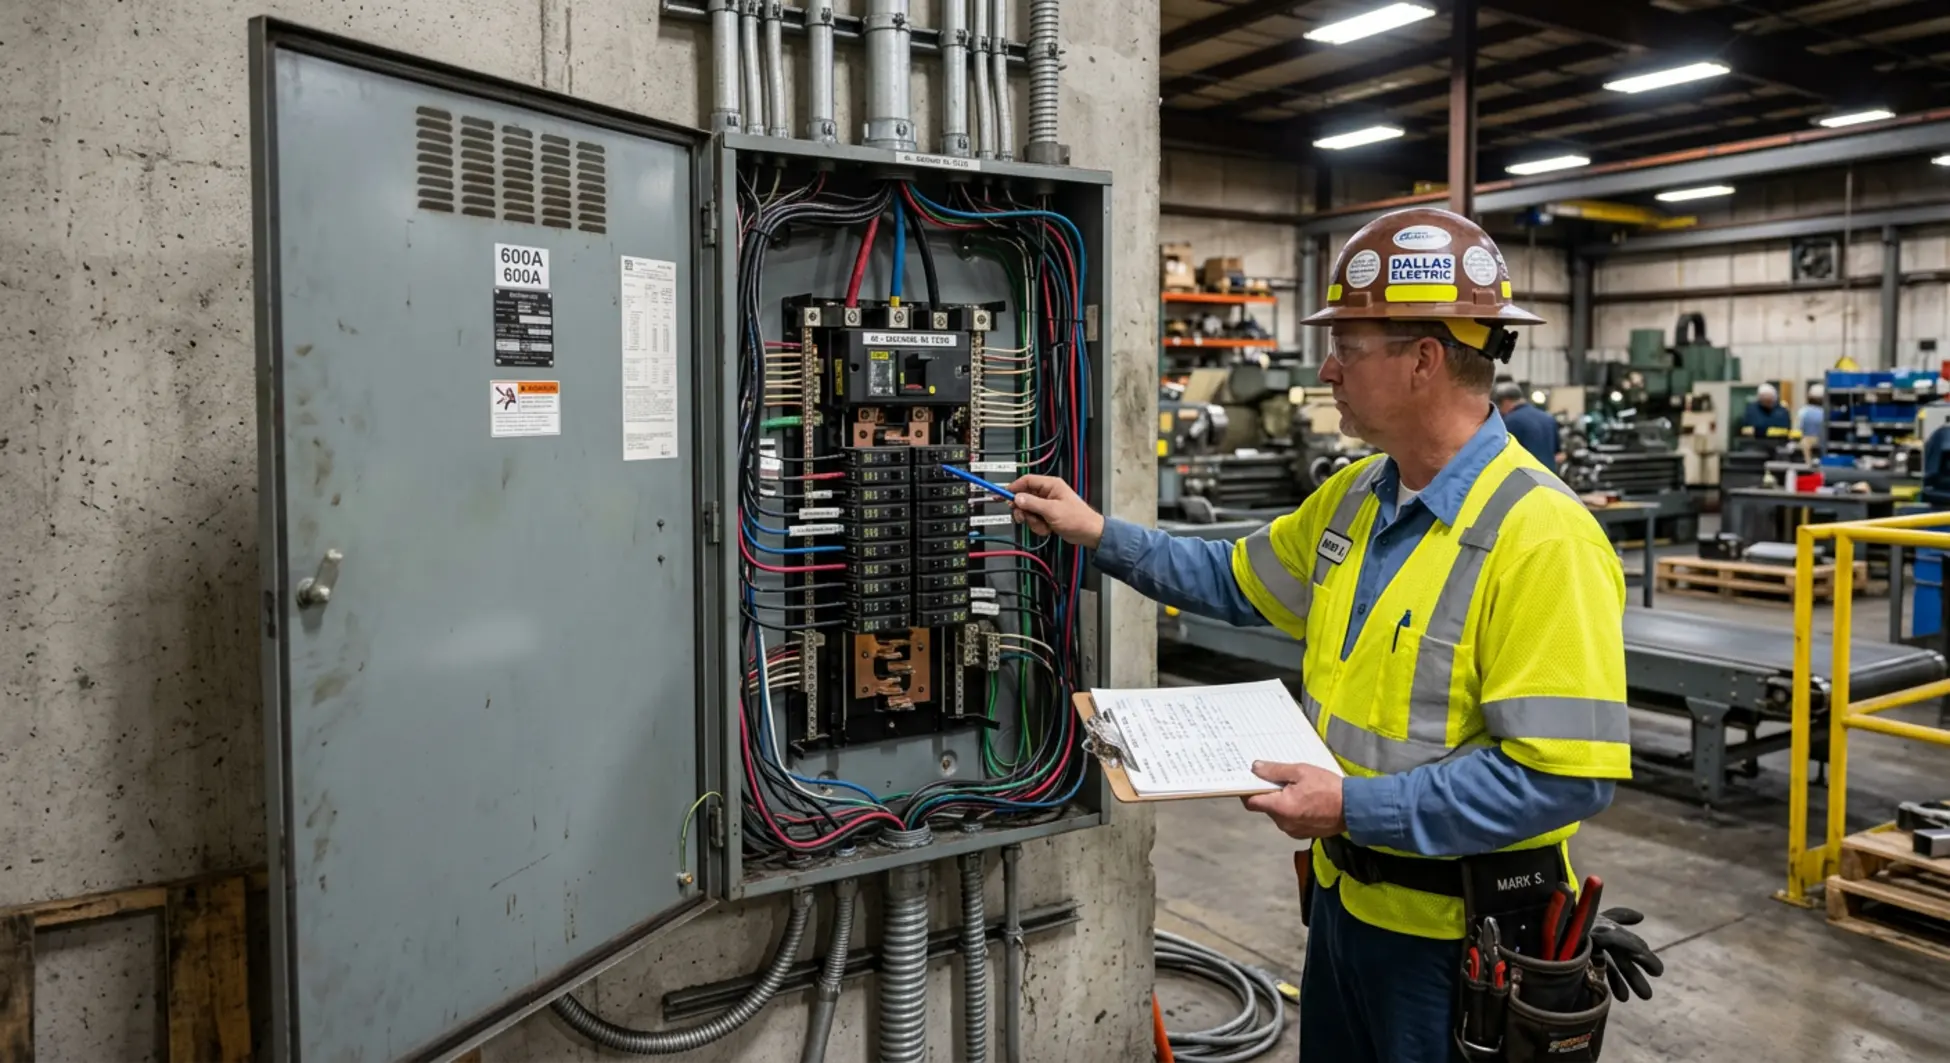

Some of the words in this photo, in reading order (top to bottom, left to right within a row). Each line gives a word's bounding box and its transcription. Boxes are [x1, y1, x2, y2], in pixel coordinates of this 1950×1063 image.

[501, 247, 544, 267] 600A
[1392, 258, 1452, 269] DALLAS
[504, 267, 541, 284] 600A
[1497, 875, 1531, 890] MARK
[1534, 871, 1545, 885] S.
